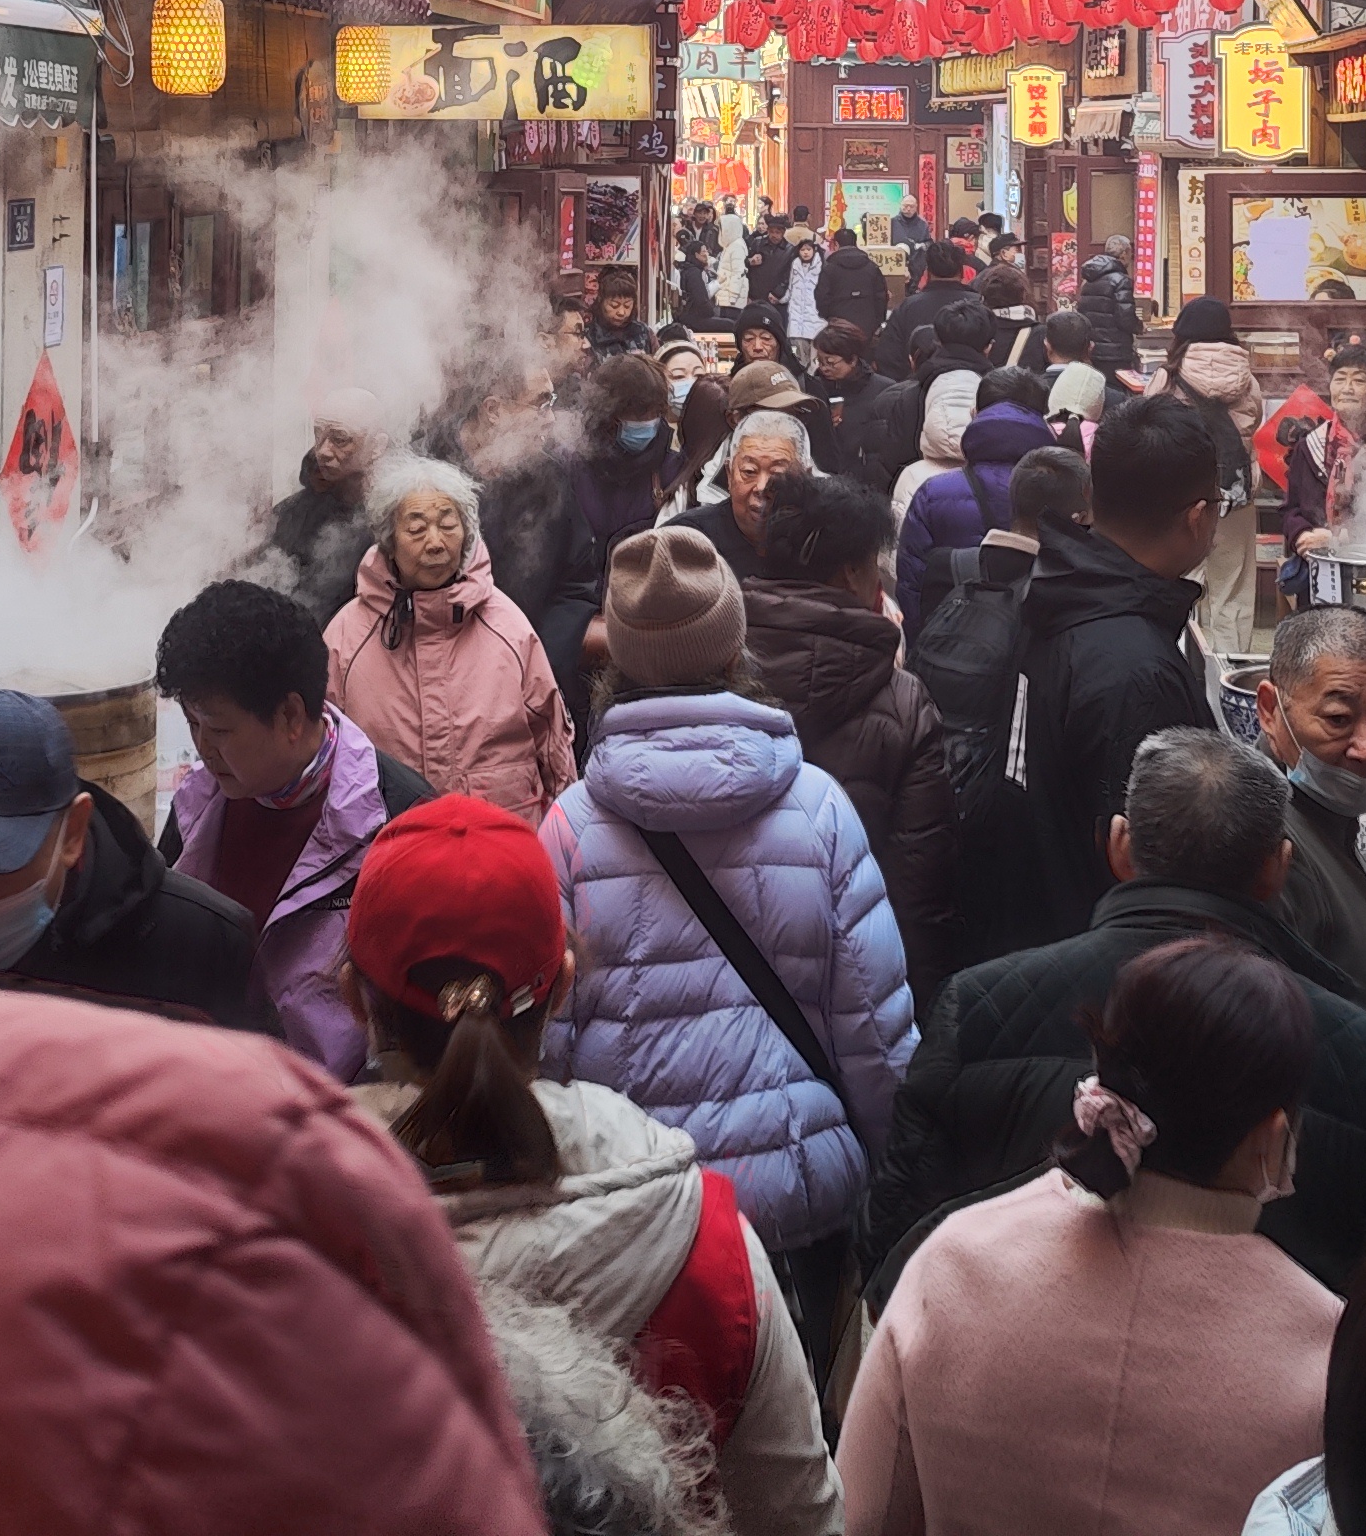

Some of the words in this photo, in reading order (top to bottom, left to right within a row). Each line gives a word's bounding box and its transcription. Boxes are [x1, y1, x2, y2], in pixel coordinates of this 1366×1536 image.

[1026, 83, 1048, 138] 饺大师
[1246, 58, 1285, 151] 坛子肉
[14, 221, 29, 243] 36
